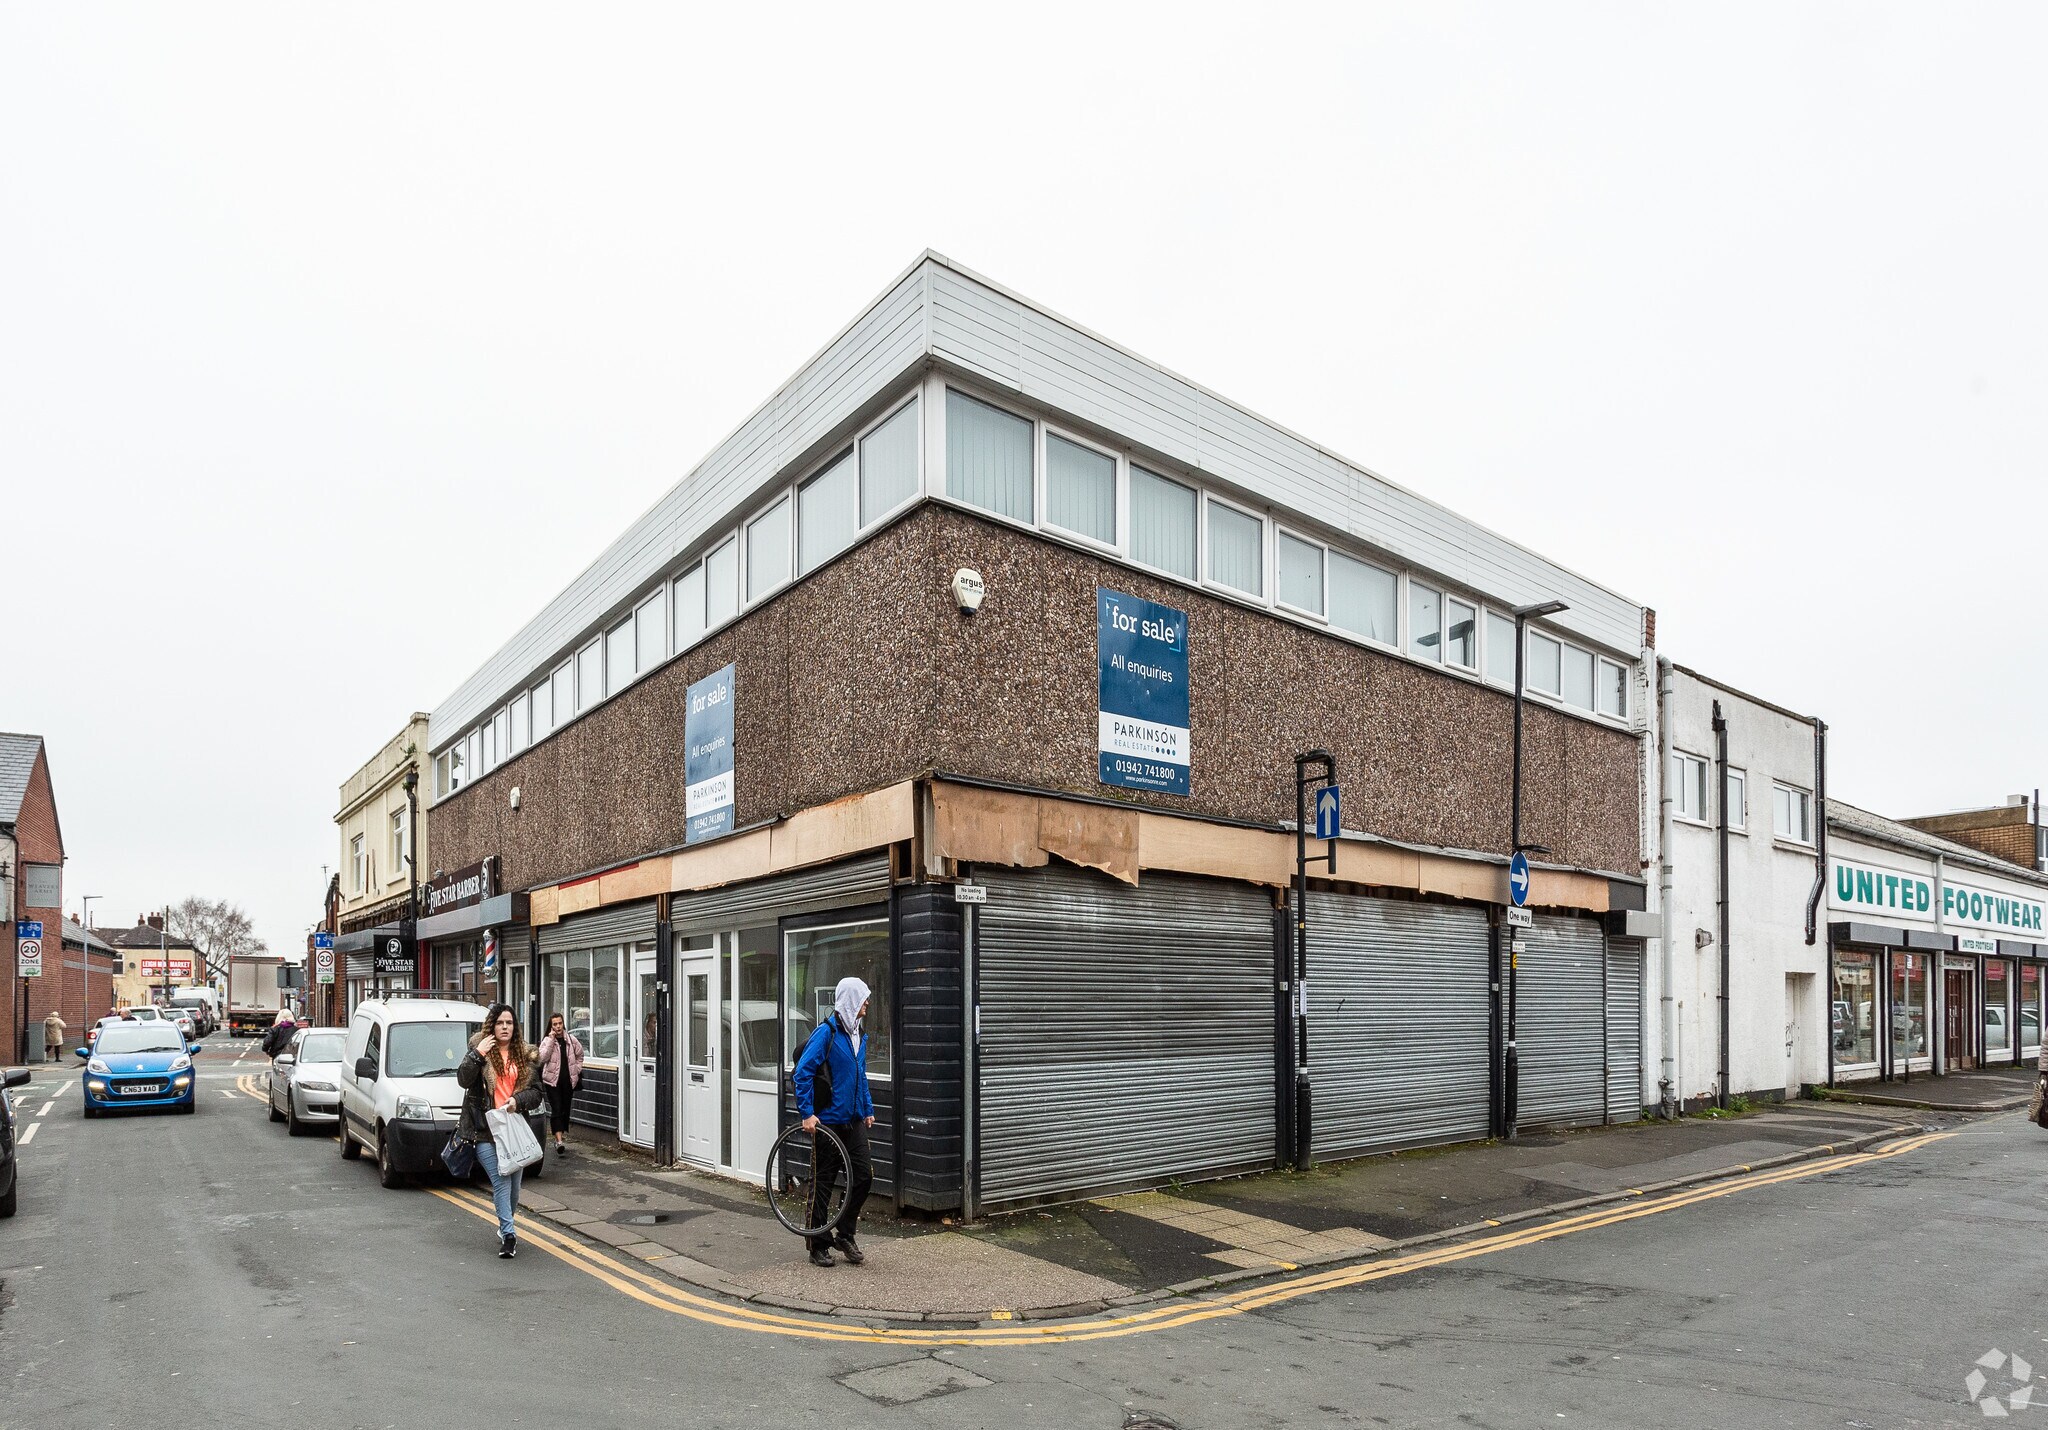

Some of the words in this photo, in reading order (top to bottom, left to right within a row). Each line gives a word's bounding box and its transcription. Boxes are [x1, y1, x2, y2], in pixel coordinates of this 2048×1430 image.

[960, 576, 983, 588] argus
[1112, 605, 1138, 634] for
[1141, 618, 1175, 644] sale
[1111, 653, 1125, 671] All
[1127, 661, 1173, 683] enquiries
[692, 694, 707, 715] for
[707, 682, 727, 706] sale
[1114, 721, 1177, 746] PARKINSÓN
[691, 745, 700, 759] All
[700, 735, 726, 757] enquiries
[1114, 738, 1131, 749] REAL
[1132, 742, 1154, 753] ESTATE
[1115, 759, 1143, 775] 01942
[1144, 764, 1175, 780] 741800
[693, 817, 708, 830] 01942
[430, 889, 442, 909] FIVE
[441, 883, 457, 905] STAR
[456, 875, 480, 900] BARBER
[1837, 865, 1930, 912] UNITED
[1943, 887, 2042, 930] FOOTWEAR
[1510, 910, 1519, 921] One
[1520, 915, 1530, 924] way
[23, 945, 37, 953] 20
[1962, 939, 1975, 949] UNITED
[1975, 940, 1994, 951] FOOTWEAR
[142, 960, 157, 968] LEIGH
[319, 955, 331, 963] 20
[500, 1151, 518, 1160] NEW
